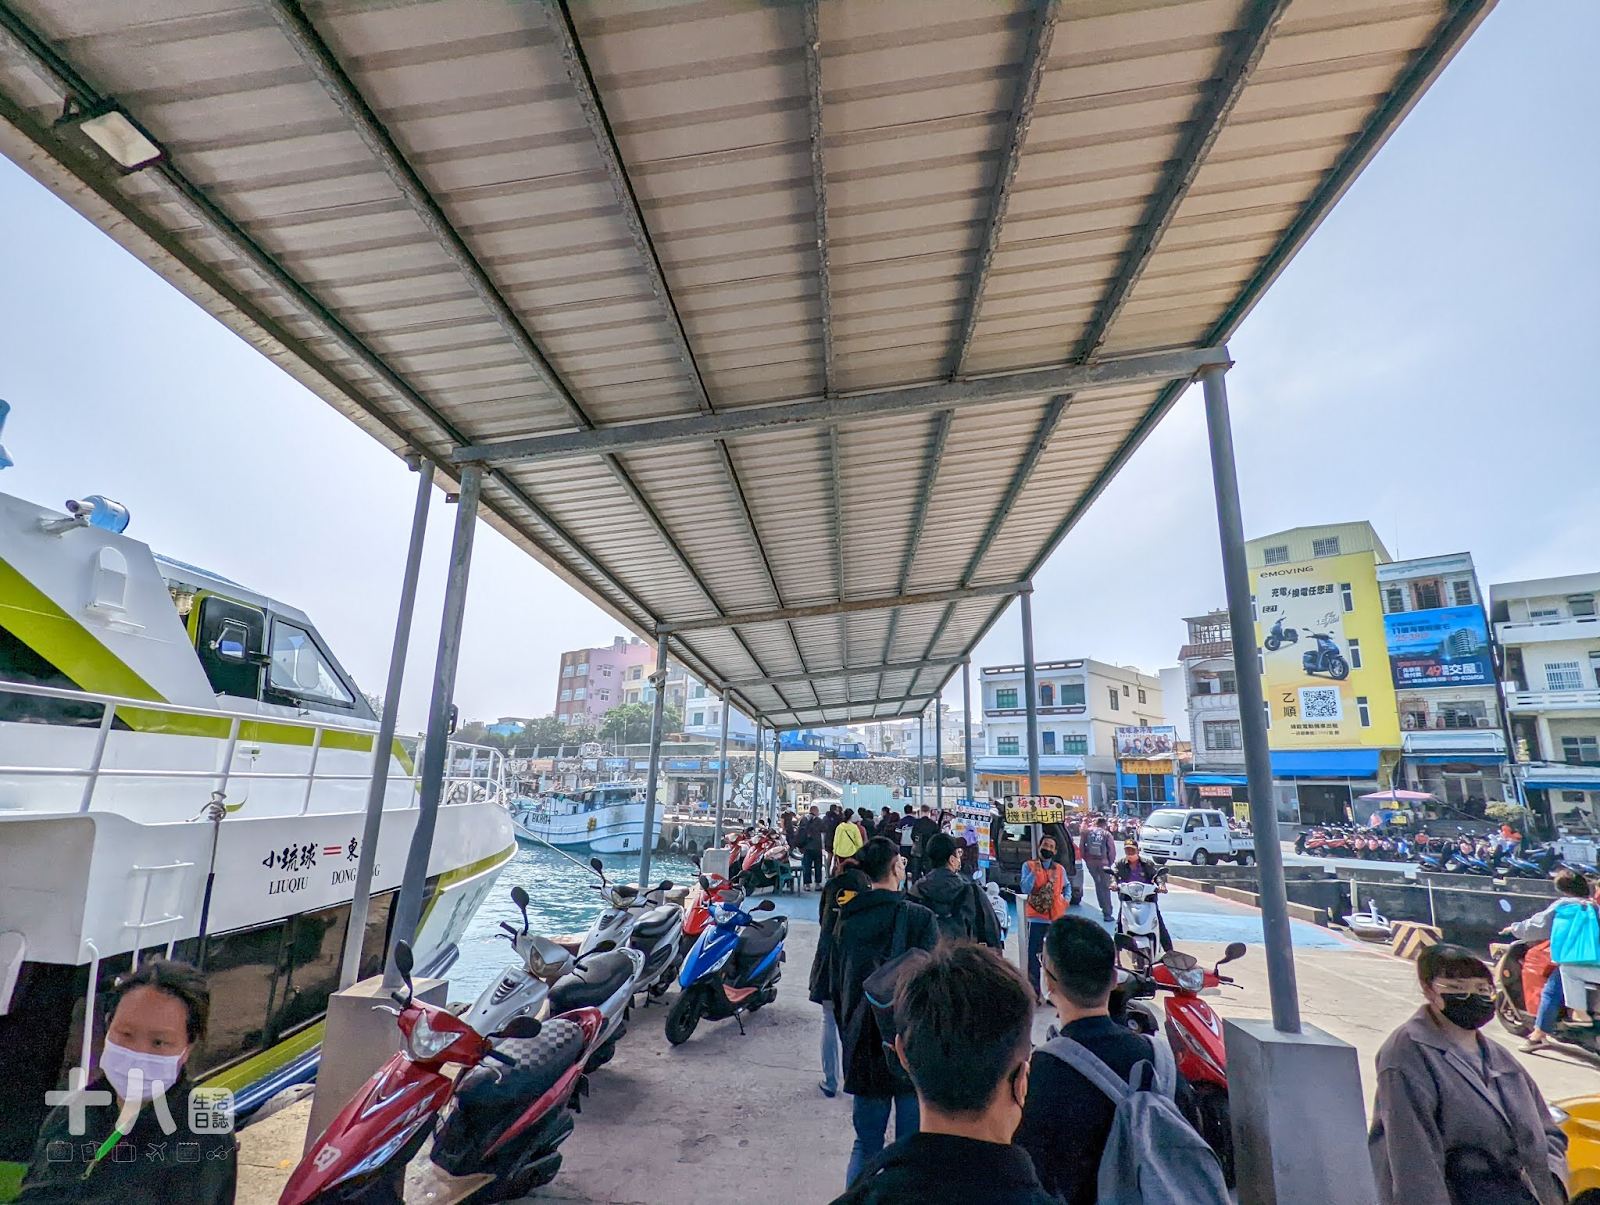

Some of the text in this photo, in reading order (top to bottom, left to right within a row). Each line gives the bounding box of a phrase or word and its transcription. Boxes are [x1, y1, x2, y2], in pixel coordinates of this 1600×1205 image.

[1006, 809, 1063, 823] 機車出租
[262, 837, 363, 872] 小琉球 東
[269, 876, 309, 895] LIUQIU
